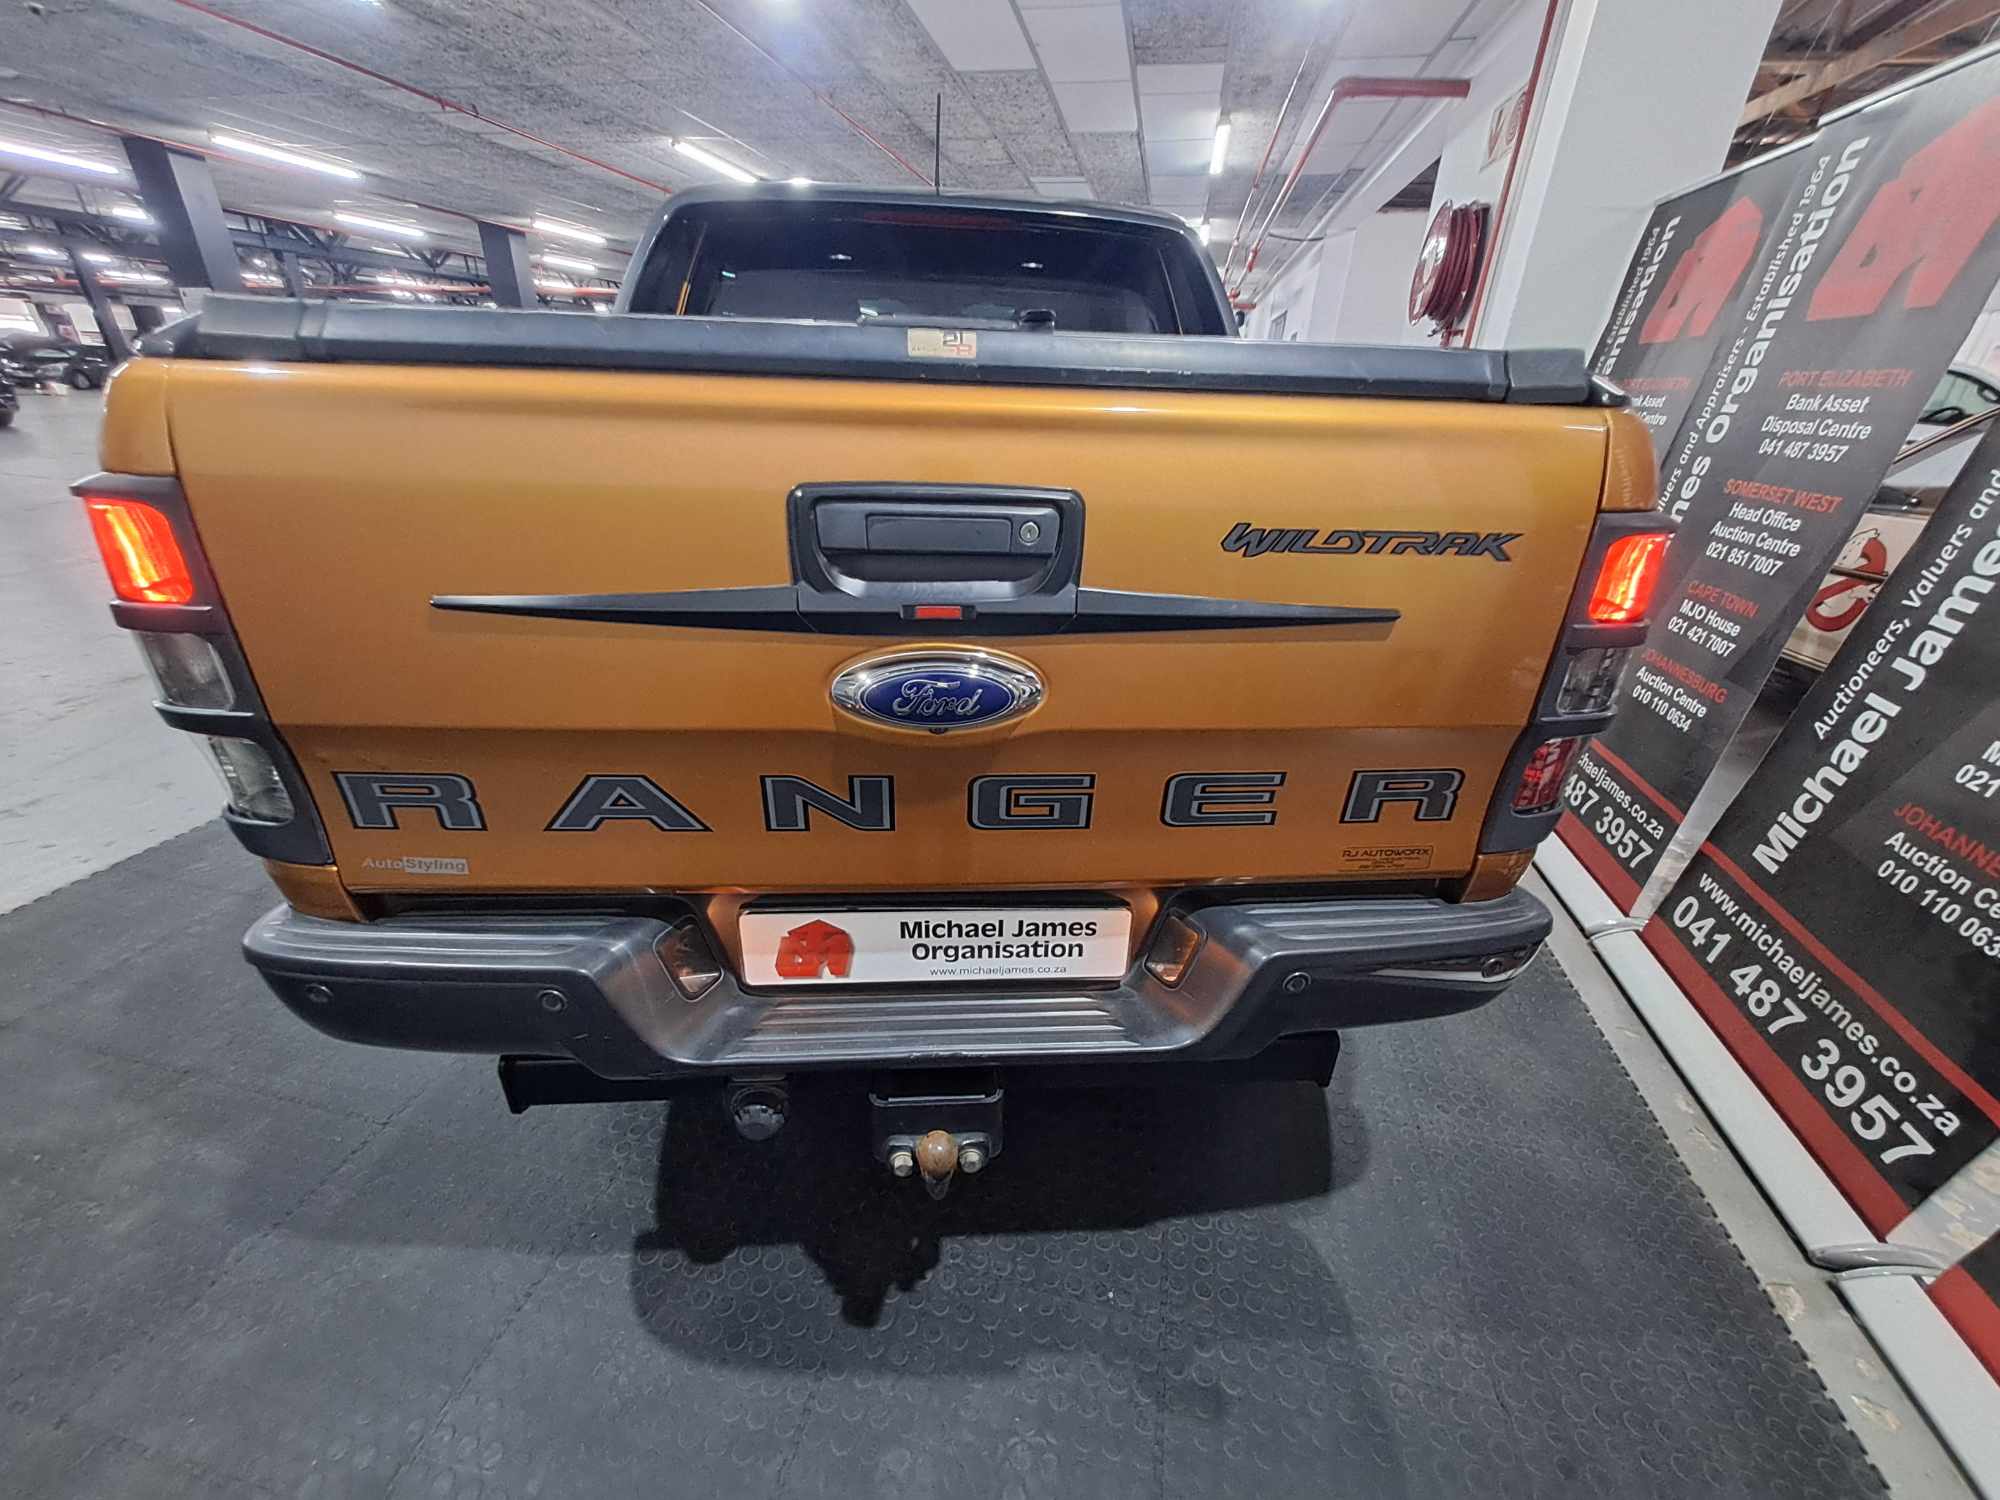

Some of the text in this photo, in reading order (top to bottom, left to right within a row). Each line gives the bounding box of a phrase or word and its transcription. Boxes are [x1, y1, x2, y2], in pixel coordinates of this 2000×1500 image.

[1679, 432, 1699, 464] and
[1696, 337, 1745, 430] Appraisers
[1746, 213, 1804, 321] Established
[1799, 154, 1832, 207] 1964
[1777, 368, 1914, 388] PORT ELIZABETH
[1785, 393, 1870, 413] Bank Asset
[1761, 416, 1872, 440] Disposal Centre
[1758, 438, 1849, 463] 041 487 3957
[1723, 478, 1843, 513] SOMERSET WEST
[1728, 502, 1801, 532] Head Office
[1220, 522, 1524, 562] WILDTRAK
[1705, 541, 1784, 576] 021 851 7007
[1709, 521, 1801, 558] Auction Centre
[1679, 598, 1741, 637] MJO House
[1687, 580, 1760, 617] CAPE TOWN
[1667, 616, 1736, 657] 021 421 7007
[1813, 616, 1912, 740] Auctioneers,
[1901, 523, 1974, 609] Valuers
[1636, 666, 1707, 718] Auction Centre
[1641, 648, 1728, 704] JOHANNESBURG
[893, 679, 982, 716] Ford
[1632, 685, 1693, 733] 010 110 0634
[1752, 525, 2000, 875] Michael Jame
[1955, 764, 2000, 798] 021
[330, 769, 1466, 832] RANGER
[1360, 848, 1430, 858] AUTOWORX
[1595, 806, 1654, 869] 3957
[1884, 831, 1972, 895] Auction
[1877, 859, 2000, 958] 010 110 063
[900, 917, 1098, 939] Michael James
[911, 940, 1084, 963] Organisation
[930, 965, 1067, 977] www.michaeljames.co.za
[1699, 872, 1961, 1137] www.michaeljames.co.za
[1672, 895, 1937, 1165] 041 487 3957
